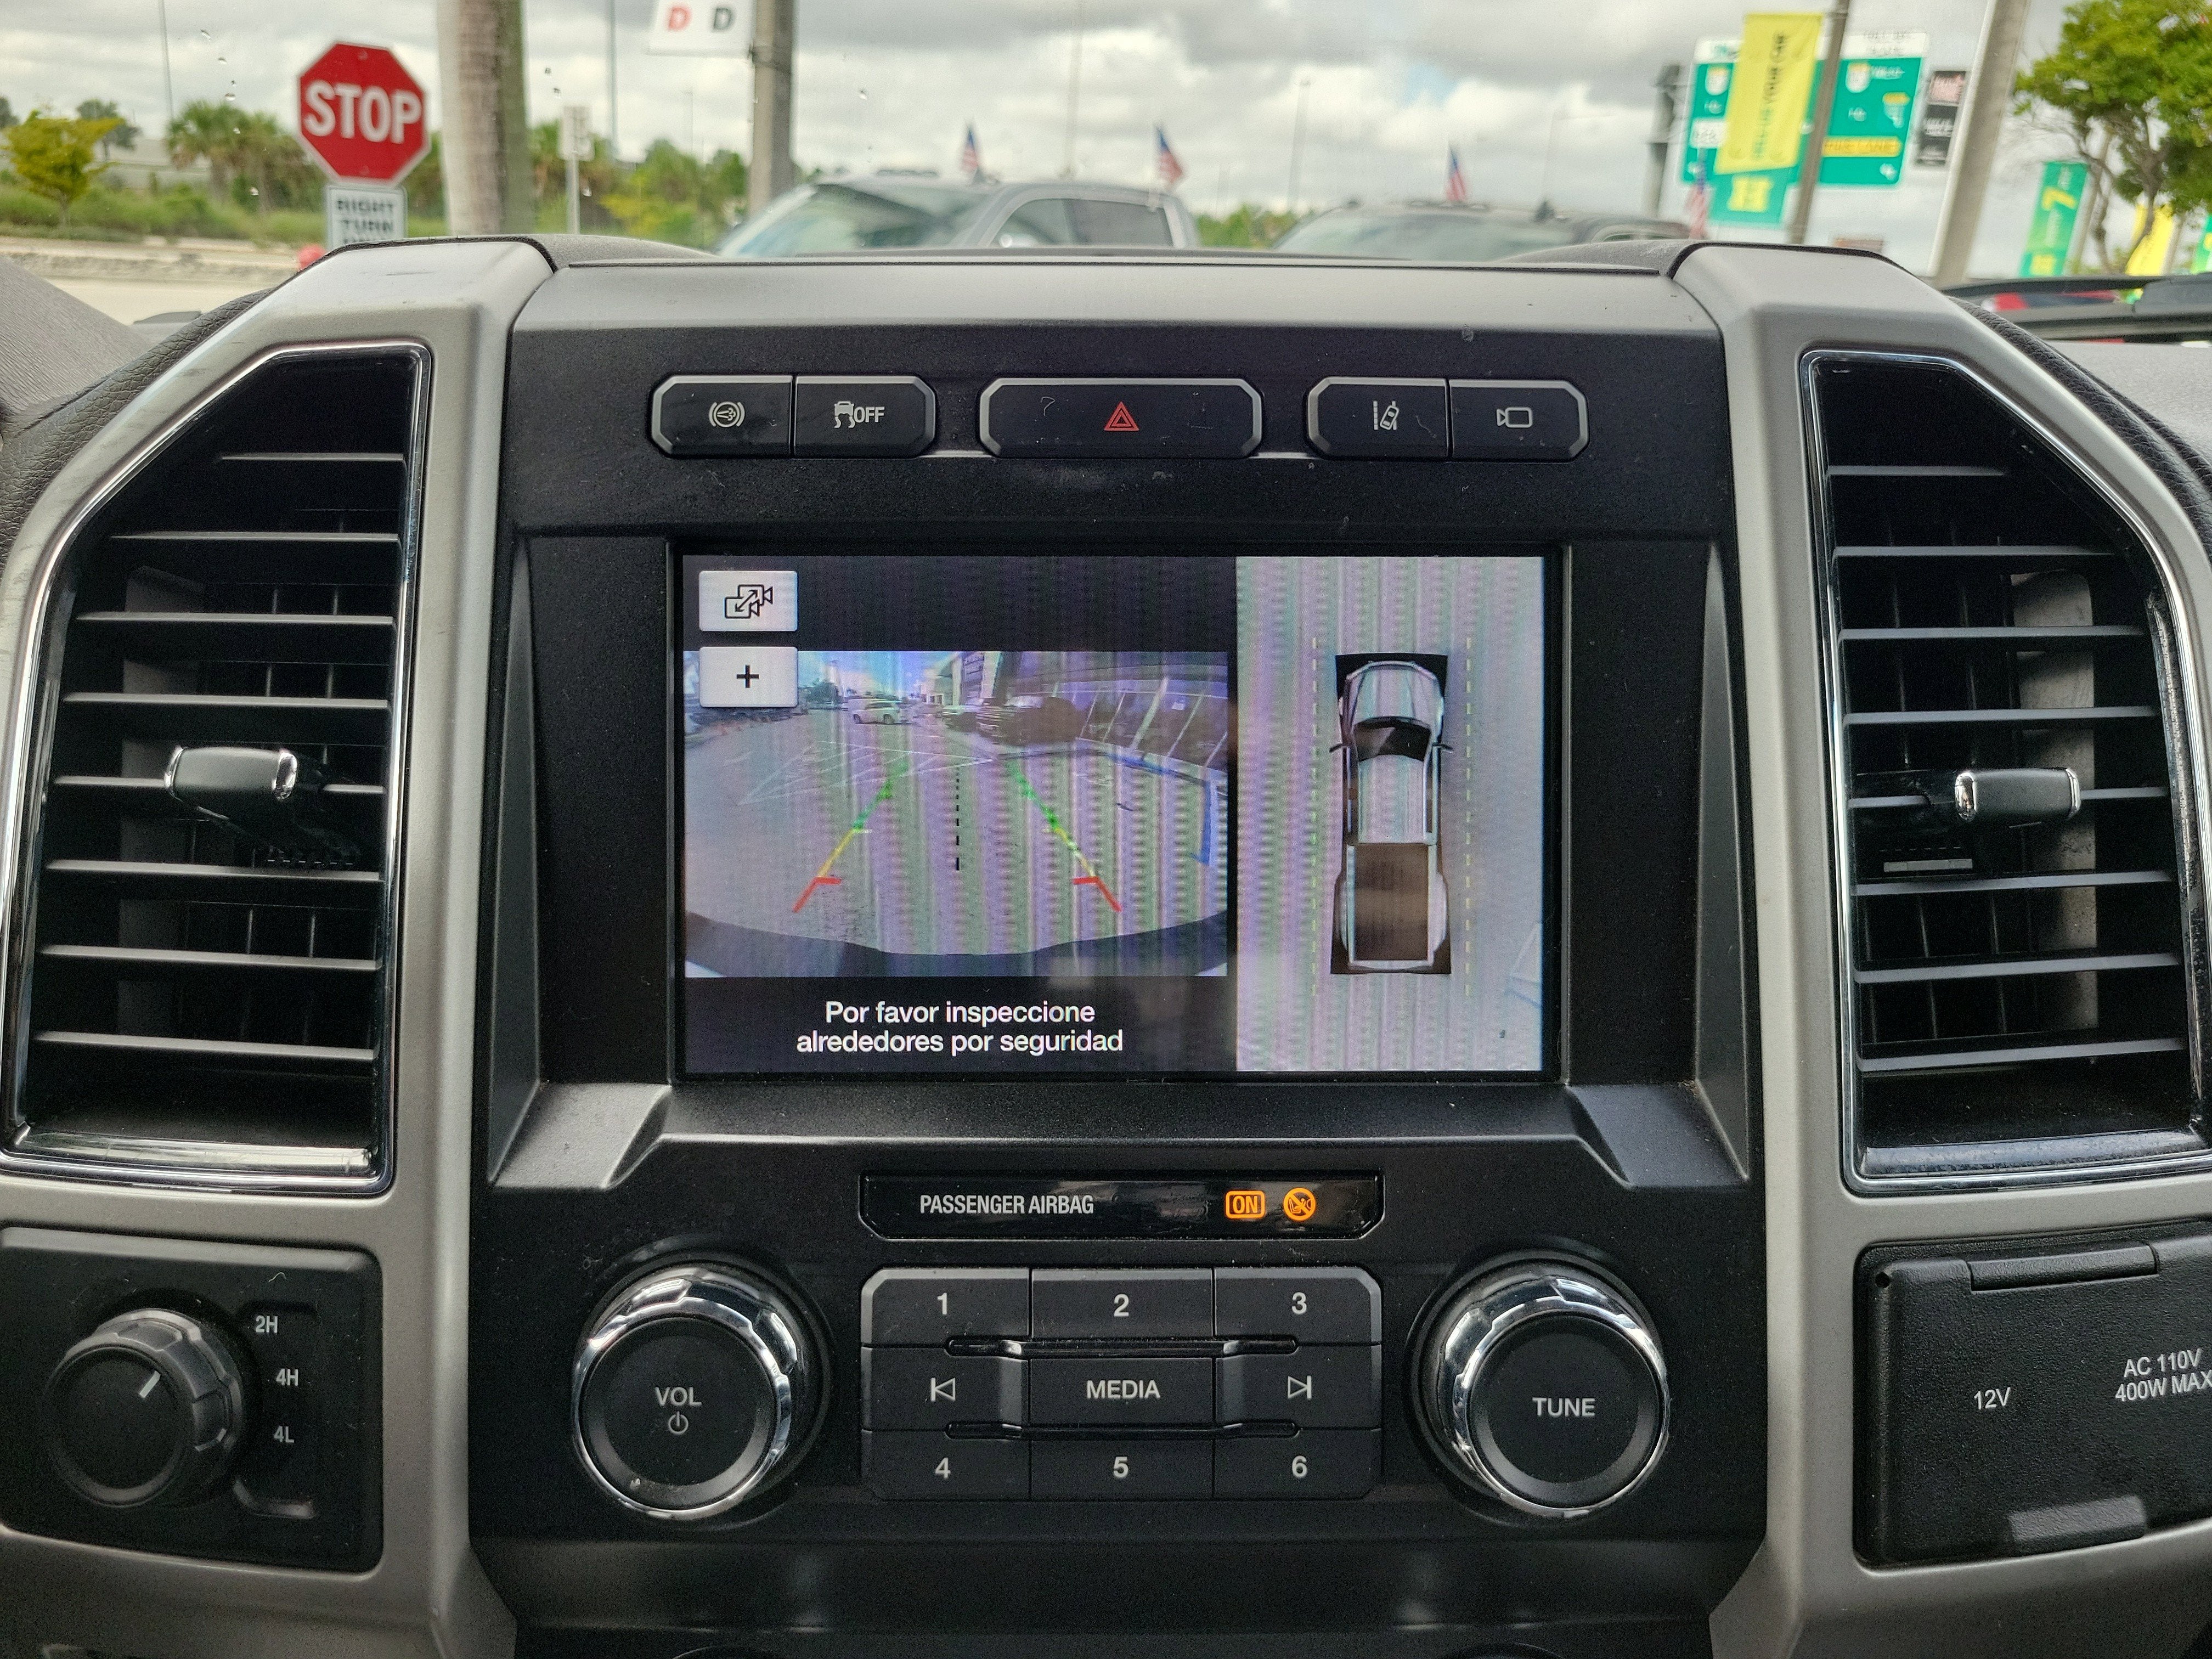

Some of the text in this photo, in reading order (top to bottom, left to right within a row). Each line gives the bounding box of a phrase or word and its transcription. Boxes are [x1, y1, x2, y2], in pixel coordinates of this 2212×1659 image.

[667, 5, 735, 31] D D
[303, 80, 423, 144] STOP
[336, 199, 393, 213] RIGHT
[341, 218, 394, 233] TURN
[853, 406, 885, 423] OFF
[826, 1000, 1096, 1028] Por favor inspeccione
[797, 1029, 1124, 1057] alrededores por seguridad
[919, 1194, 1094, 1214] PASSENGER AIRBAG
[1233, 1195, 1258, 1214] ON
[937, 1293, 948, 1315] 1
[1114, 1294, 1130, 1317] 2
[1291, 1292, 1307, 1315] 3
[255, 1315, 278, 1334] 2H
[2123, 1348, 2203, 1378] AC 110V
[275, 1368, 298, 1386] 4H
[2115, 1369, 2212, 1402] 400W MAX
[654, 1386, 702, 1407] VOL
[1086, 1380, 1161, 1399] MEDIA
[1974, 1387, 2011, 1410] 12V
[1532, 1397, 1596, 1417] TUNE
[274, 1425, 295, 1443] 4L
[934, 1457, 951, 1479] 4
[1113, 1457, 1129, 1479] 5
[1291, 1455, 1307, 1479] 6
